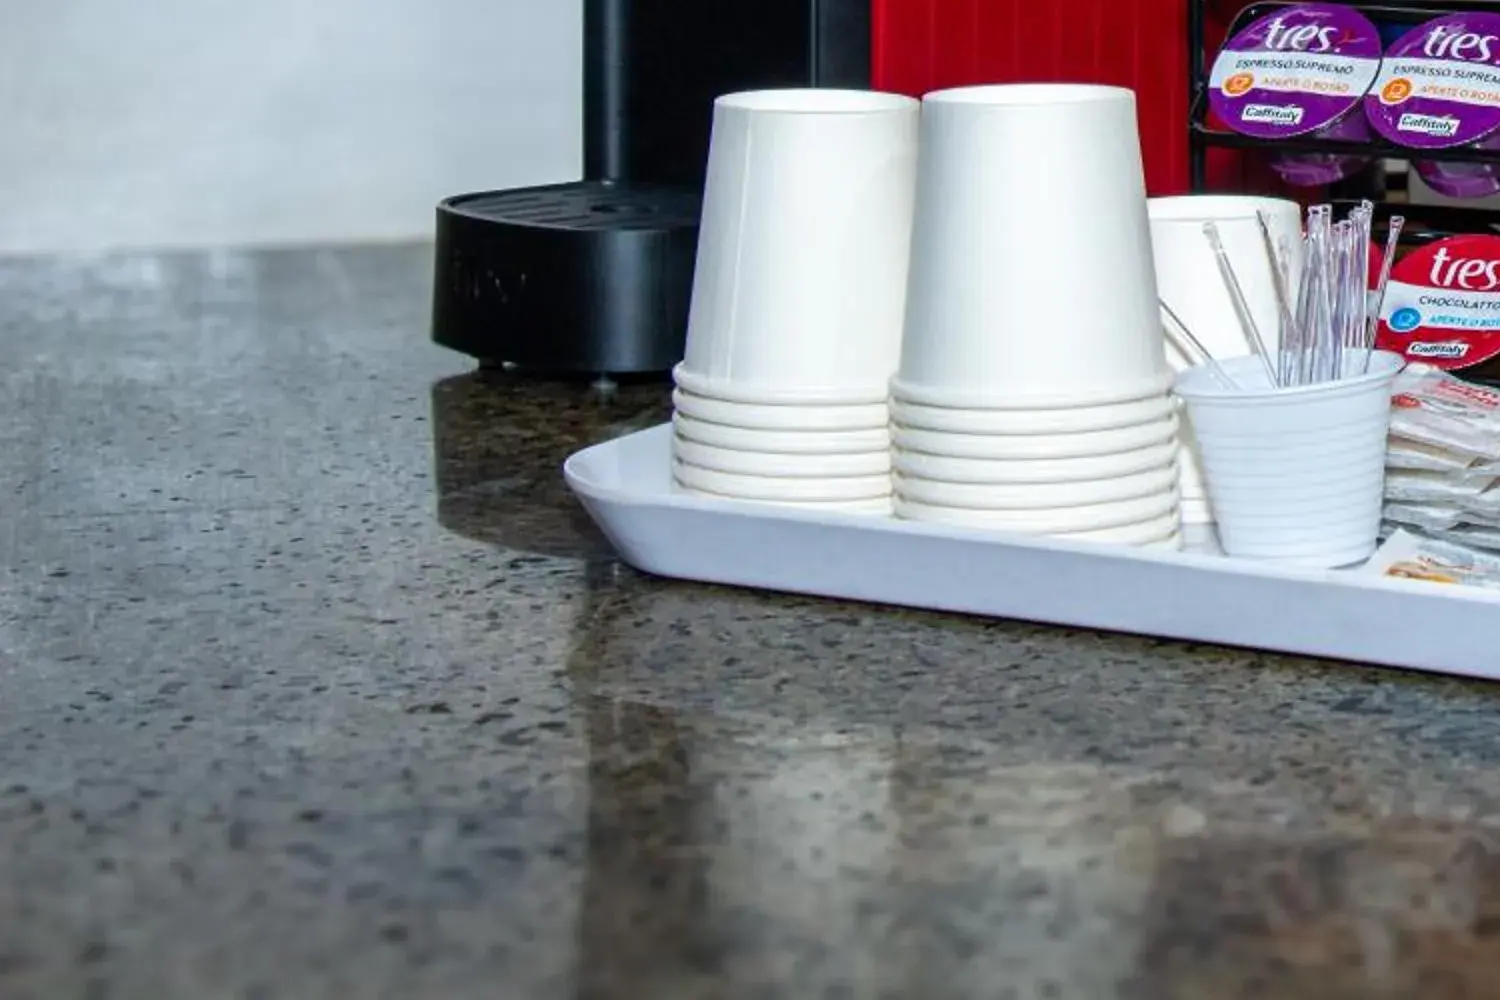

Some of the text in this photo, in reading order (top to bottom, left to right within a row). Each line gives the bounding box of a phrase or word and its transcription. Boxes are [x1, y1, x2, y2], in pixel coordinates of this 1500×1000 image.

[1265, 17, 1337, 52] tres
[1424, 25, 1499, 61] tres
[1235, 60, 1354, 74] ESPRESSO SUPREMO
[1393, 65, 1451, 77] ESPRESSO
[1246, 108, 1298, 120] Caffitaly
[1402, 116, 1454, 130] Caffitaly
